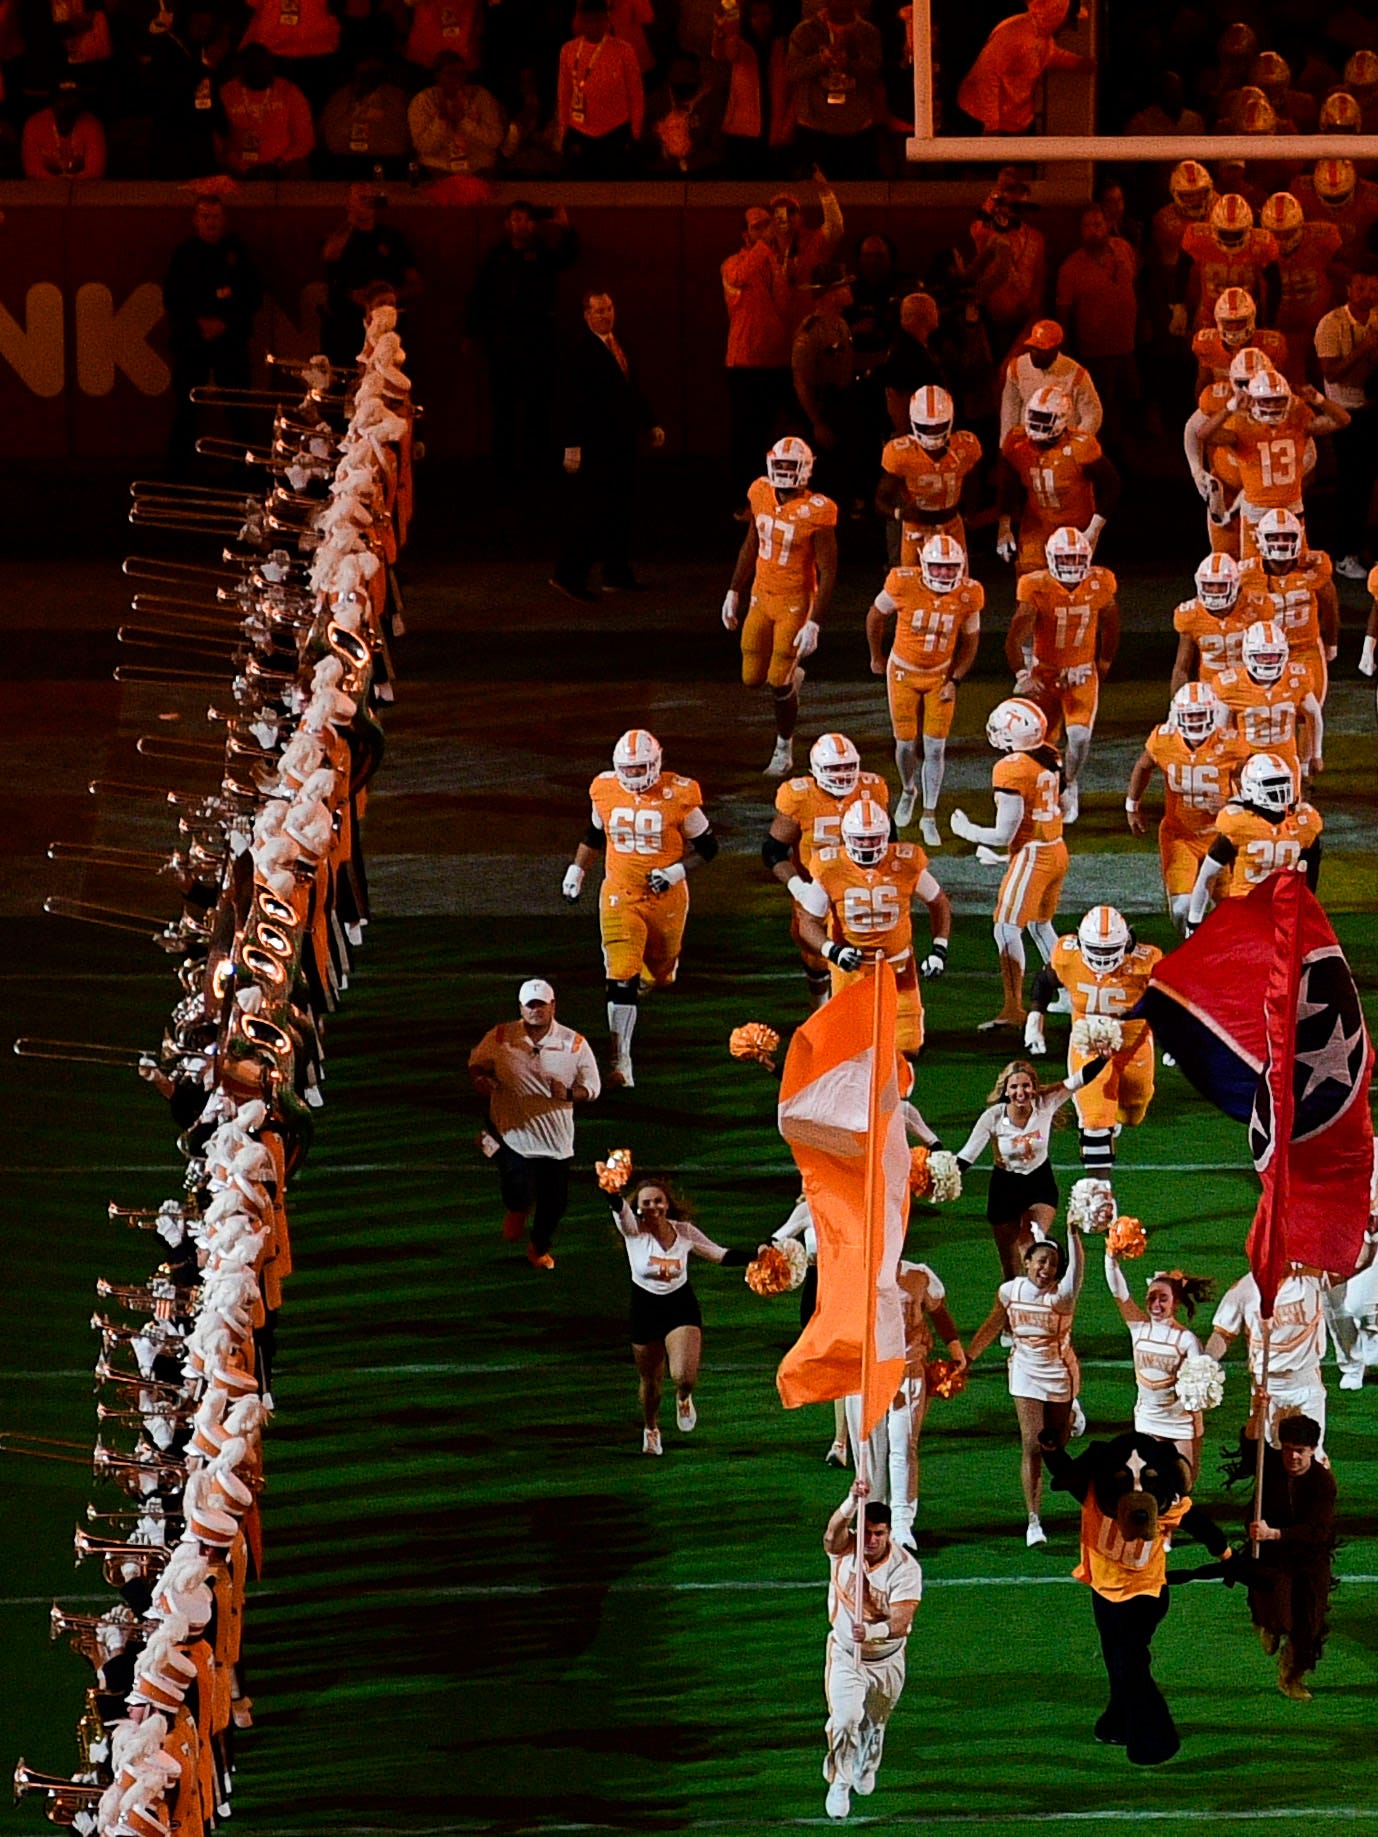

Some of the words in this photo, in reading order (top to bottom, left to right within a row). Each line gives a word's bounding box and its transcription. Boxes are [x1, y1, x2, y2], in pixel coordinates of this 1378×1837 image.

[1256, 438, 1297, 488] 13
[1029, 466, 1061, 508] 11
[755, 512, 797, 566] 97
[1053, 603, 1092, 649] 17
[1006, 711, 1021, 731] T
[1244, 701, 1298, 748] 60
[607, 806, 665, 855] 68
[843, 884, 901, 934] 65
[1012, 1129, 1041, 1161] T
[648, 1256, 681, 1283] T
